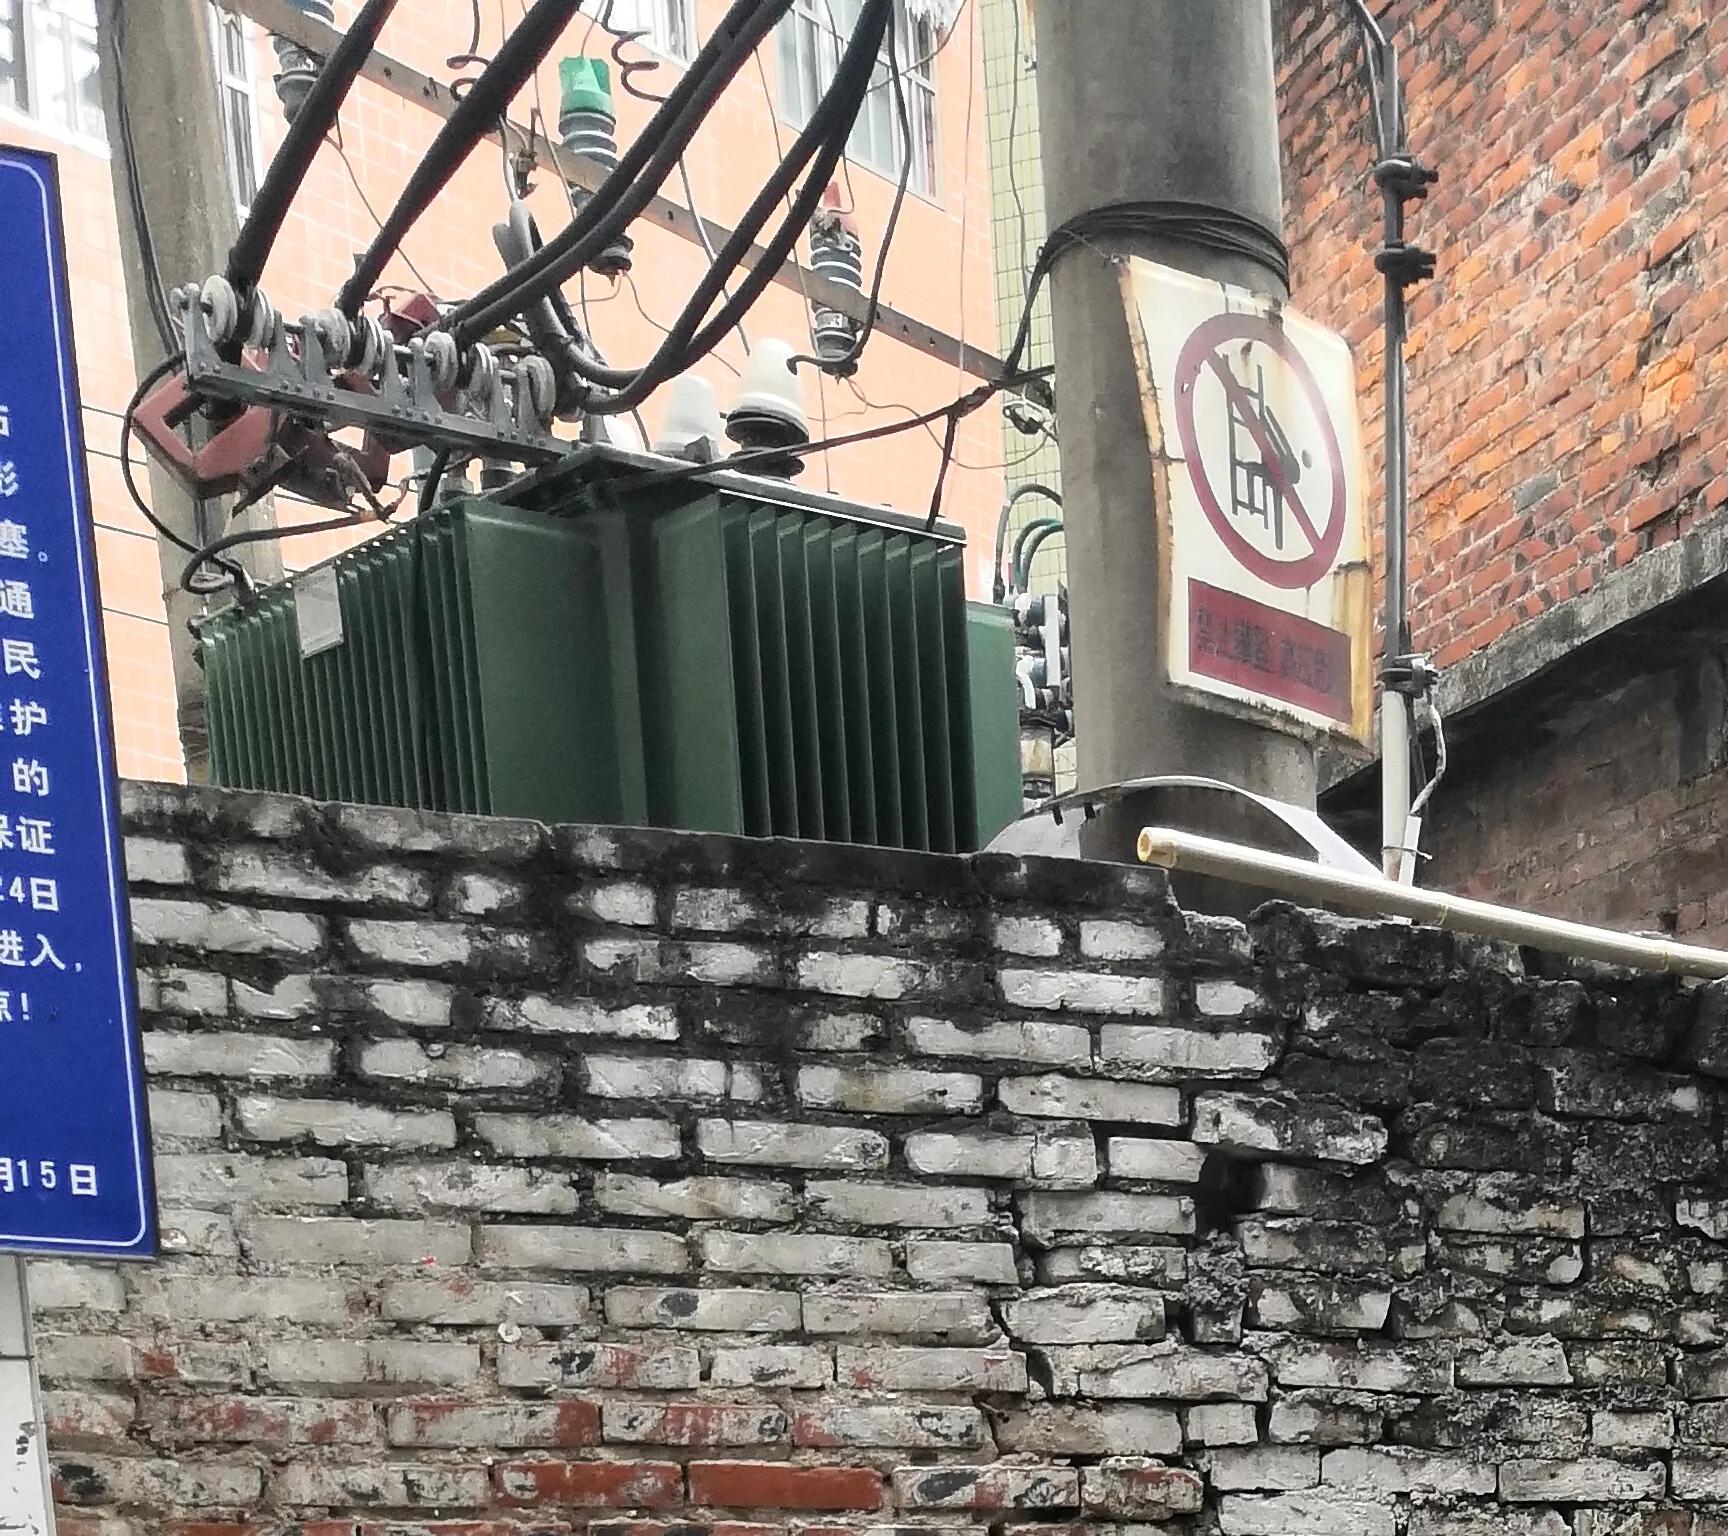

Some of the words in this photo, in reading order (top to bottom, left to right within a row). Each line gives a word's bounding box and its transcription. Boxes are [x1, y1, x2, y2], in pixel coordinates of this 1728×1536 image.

[2, 637, 42, 680] 民
[0, 698, 47, 735] 护
[12, 757, 50, 798] 的
[0, 876, 60, 912] 4日
